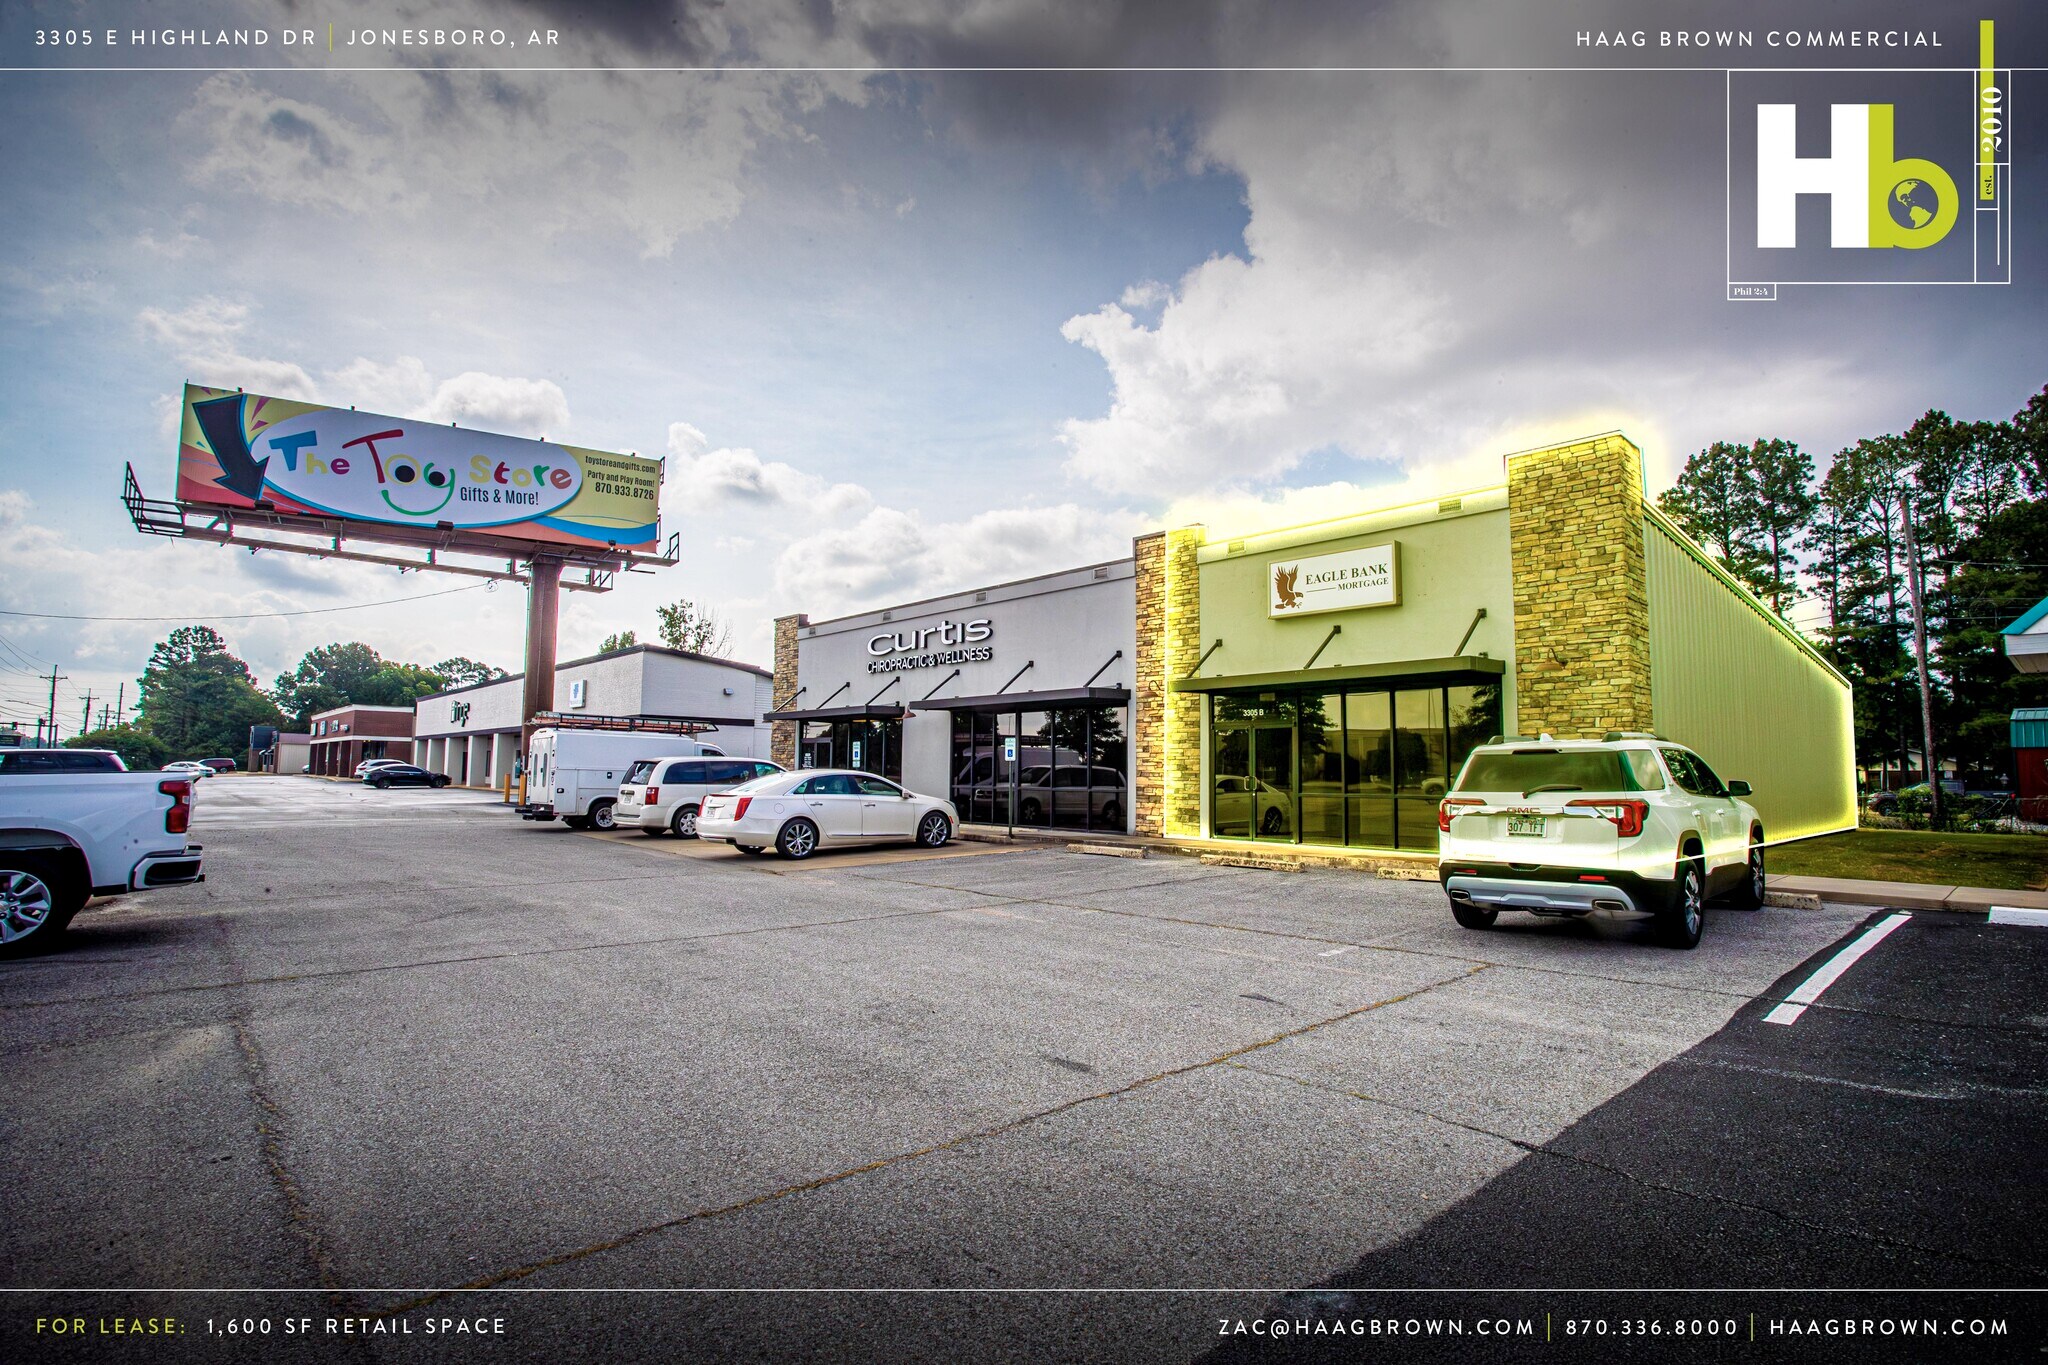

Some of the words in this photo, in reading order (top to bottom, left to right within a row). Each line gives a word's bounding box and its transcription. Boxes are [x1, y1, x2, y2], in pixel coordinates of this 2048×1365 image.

[268, 430, 350, 475] The
[342, 429, 456, 516] Toy
[469, 454, 573, 490] Store
[585, 456, 656, 473] toystoreandgifts.com
[587, 470, 605, 481] Party
[606, 474, 619, 482] and
[620, 475, 635, 485] Play
[635, 477, 655, 487] Room!
[460, 486, 489, 503] Gifts
[493, 488, 502, 503] &
[505, 489, 539, 506] More!
[595, 482, 654, 500] 870.933.8726
[1305, 569, 1348, 586] EAGLE
[1351, 563, 1388, 579] BANK
[1337, 576, 1390, 592] MORTGAGE
[866, 653, 928, 675] CHIROPRACTIC
[929, 653, 937, 667] &
[937, 646, 993, 665] WELLNESS
[1243, 709, 1259, 717] 3305
[1506, 806, 1542, 814] GMC
[1508, 822, 1524, 832] 307
